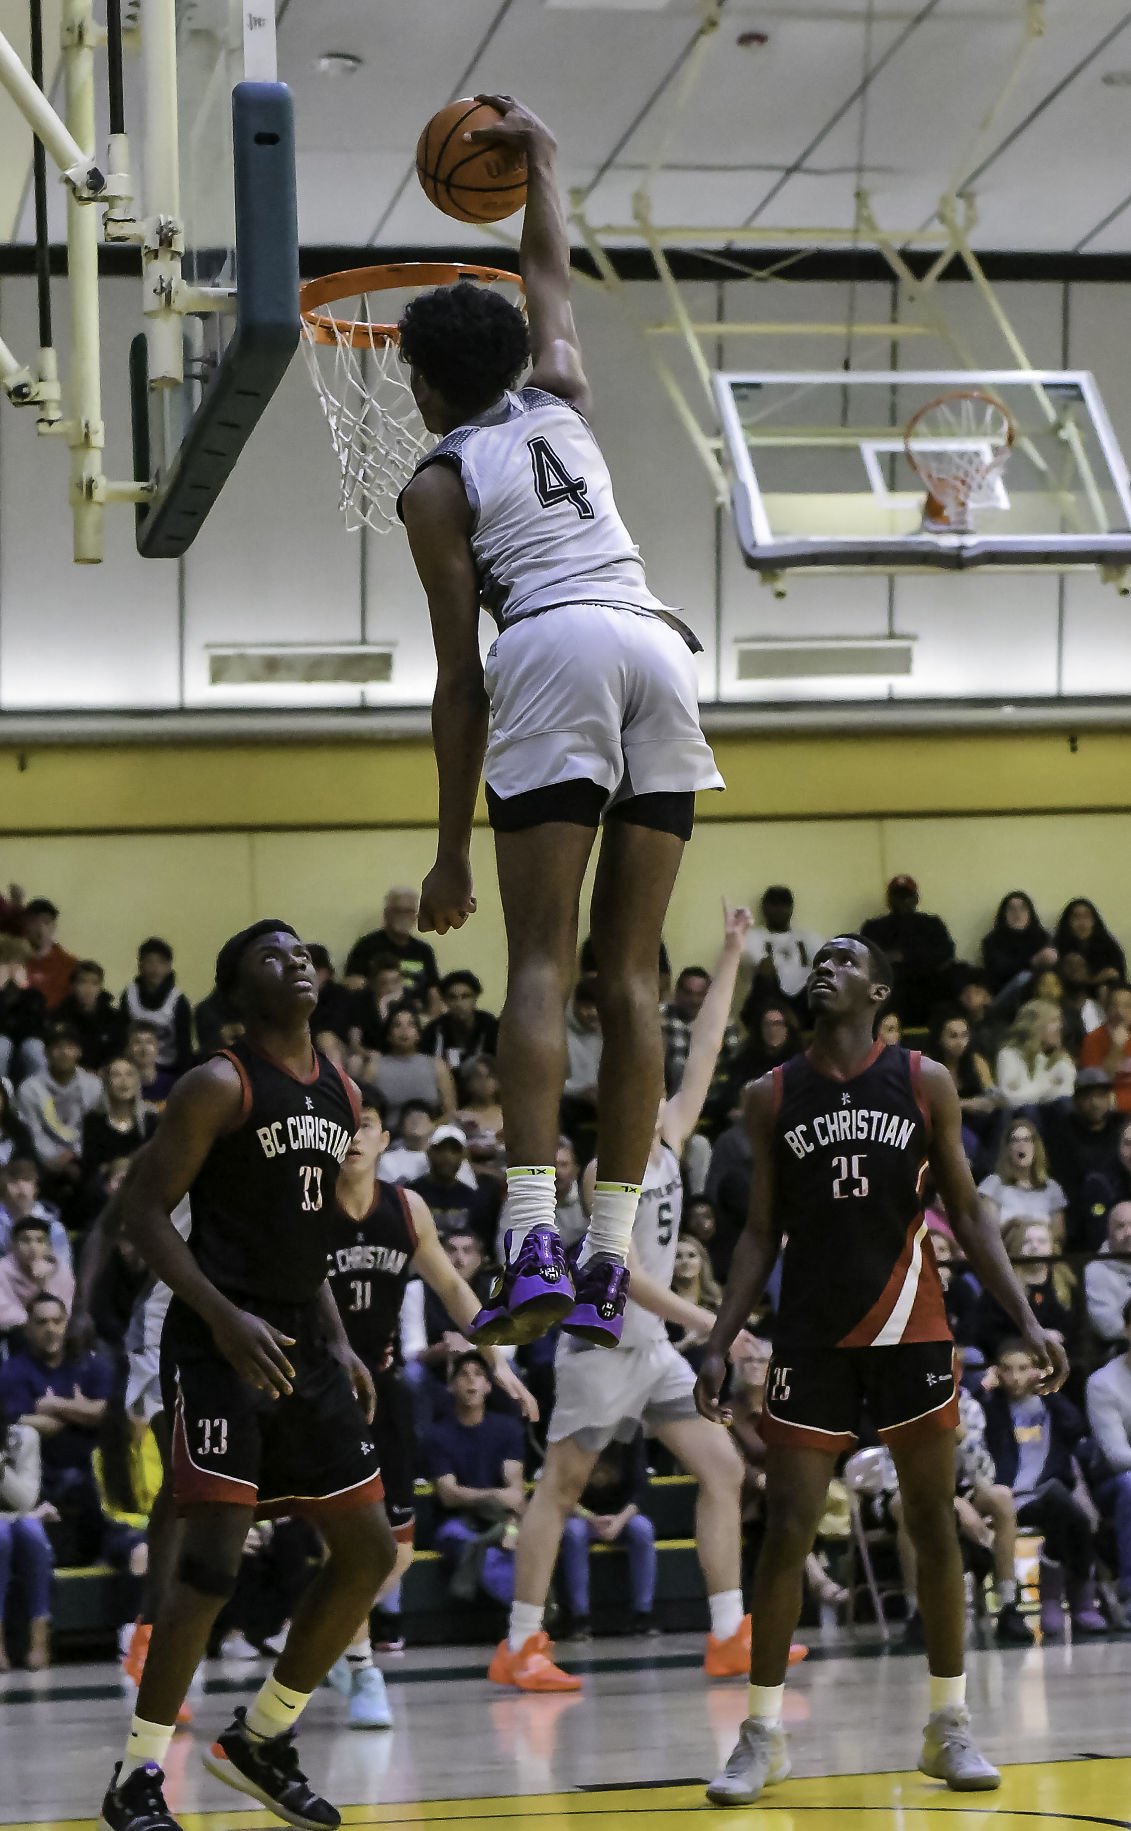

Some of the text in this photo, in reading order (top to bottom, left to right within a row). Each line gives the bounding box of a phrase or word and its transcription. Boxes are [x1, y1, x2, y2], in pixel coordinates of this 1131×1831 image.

[527, 436, 594, 519] 4
[256, 1121, 286, 1158] BC
[784, 1109, 916, 1159] BC CHRISTIAN
[299, 1166, 323, 1212] 33
[832, 1154, 869, 1199] 25
[349, 1280, 371, 1311] 31
[771, 1367, 793, 1401] 25
[197, 1418, 228, 1455] 33
